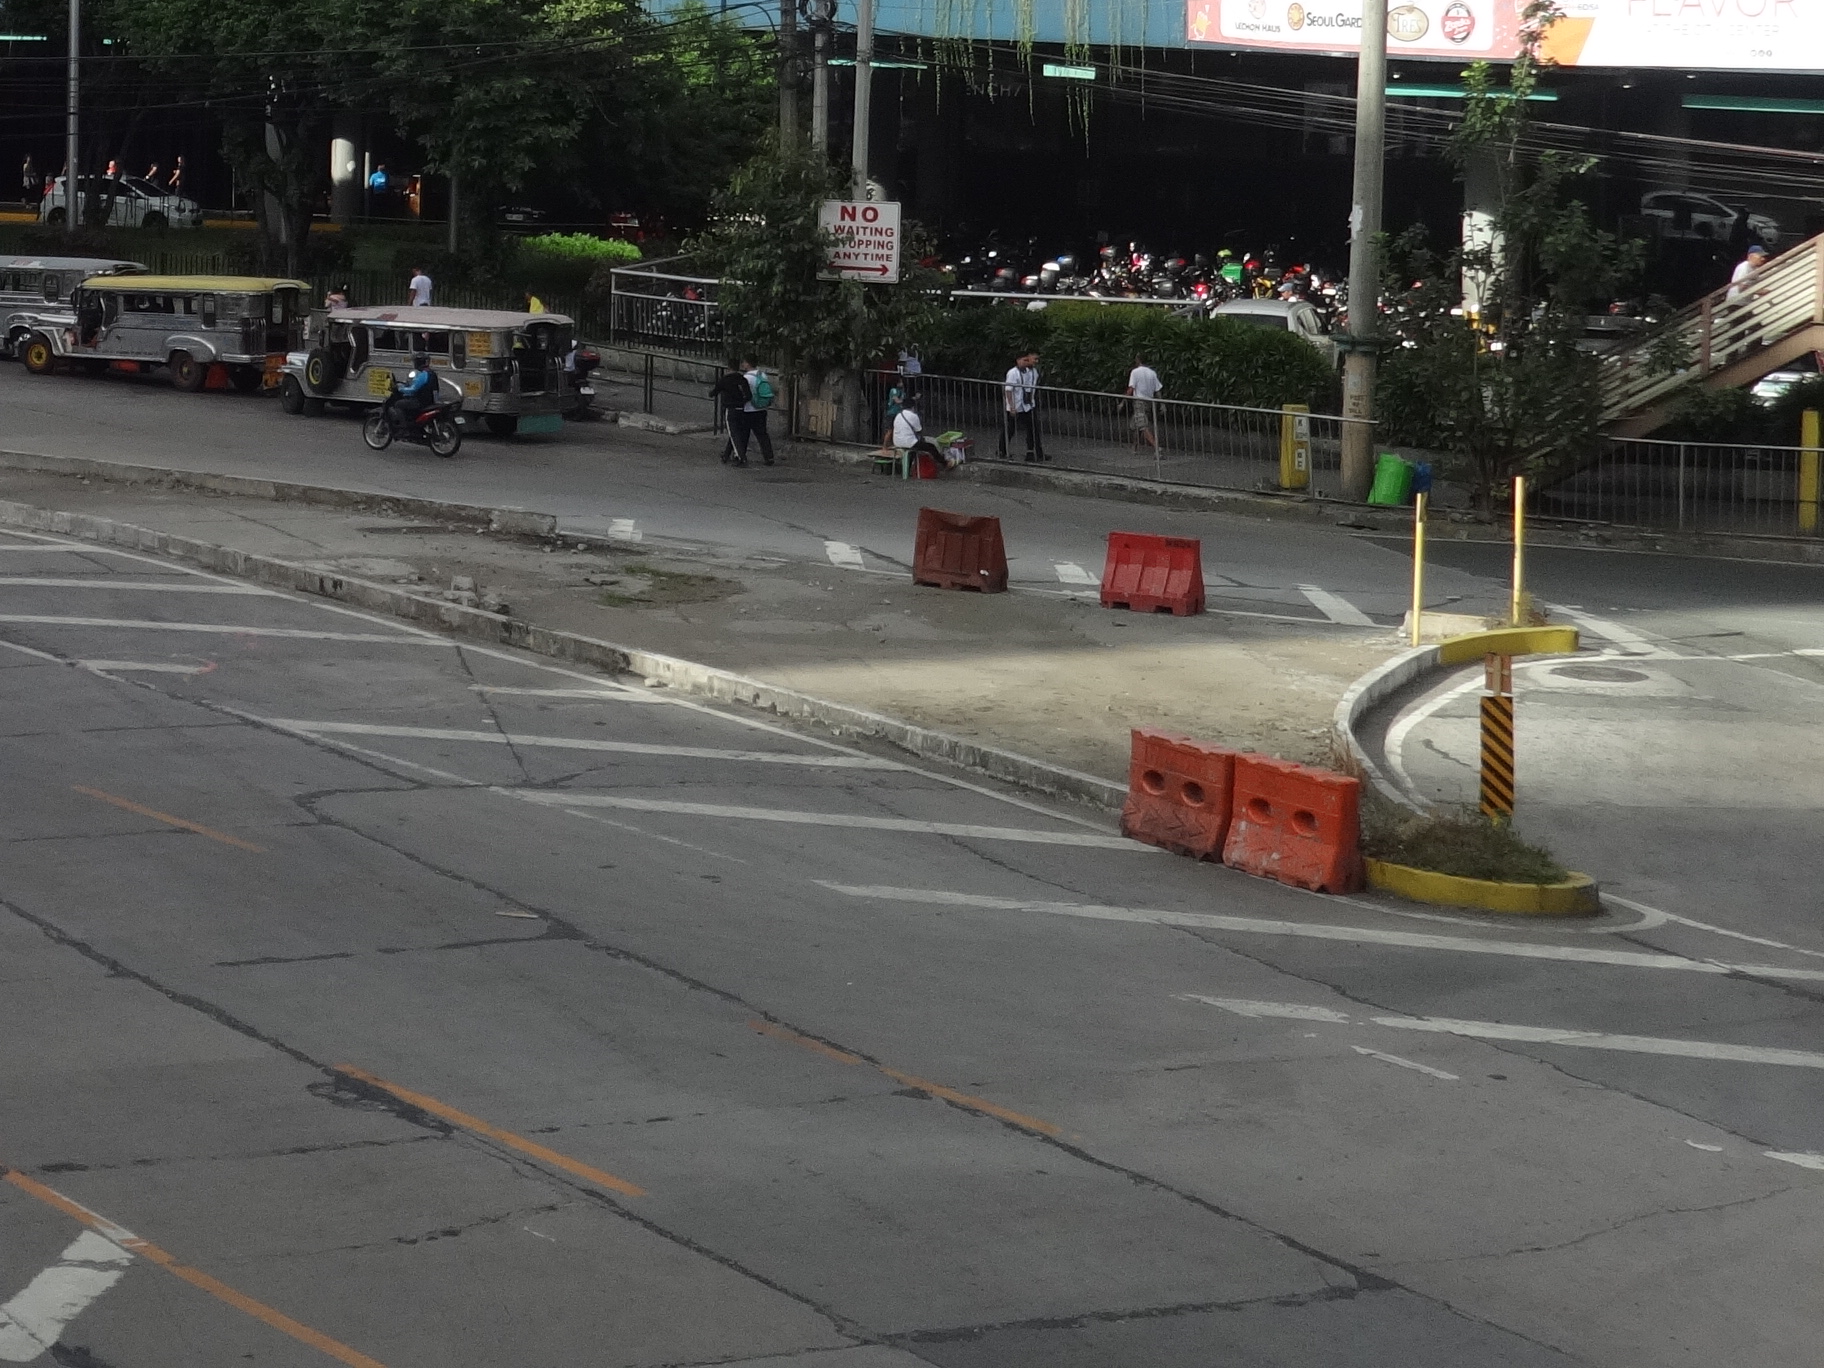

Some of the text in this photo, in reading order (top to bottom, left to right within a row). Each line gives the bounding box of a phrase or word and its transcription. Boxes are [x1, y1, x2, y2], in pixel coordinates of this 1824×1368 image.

[1306, 12, 1335, 27] SEOUL
[840, 205, 879, 223] NO
[833, 224, 894, 237] WAITING
[833, 251, 893, 262] ANYTIME
